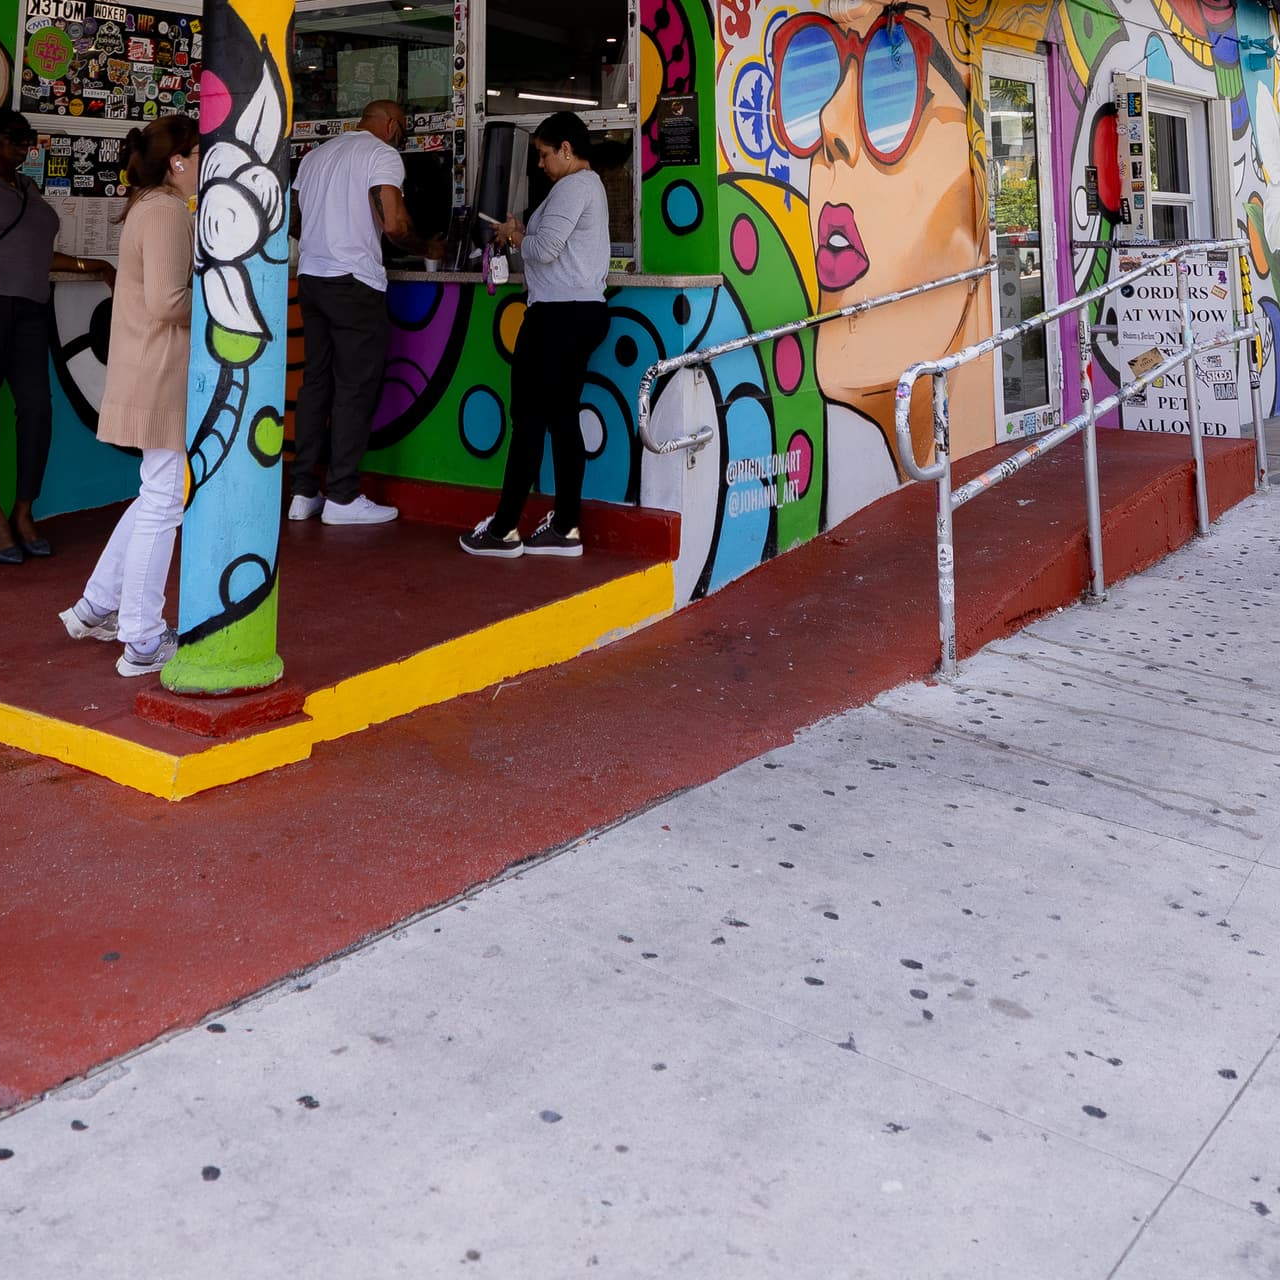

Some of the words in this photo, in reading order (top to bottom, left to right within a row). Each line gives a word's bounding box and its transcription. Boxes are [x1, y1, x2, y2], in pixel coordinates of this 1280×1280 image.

[95, 4, 125, 21] WOKER
[1137, 286, 1209, 300] ORDRS
[1122, 309, 1143, 322] AT
[729, 479, 800, 518] @JOHANN_ART
